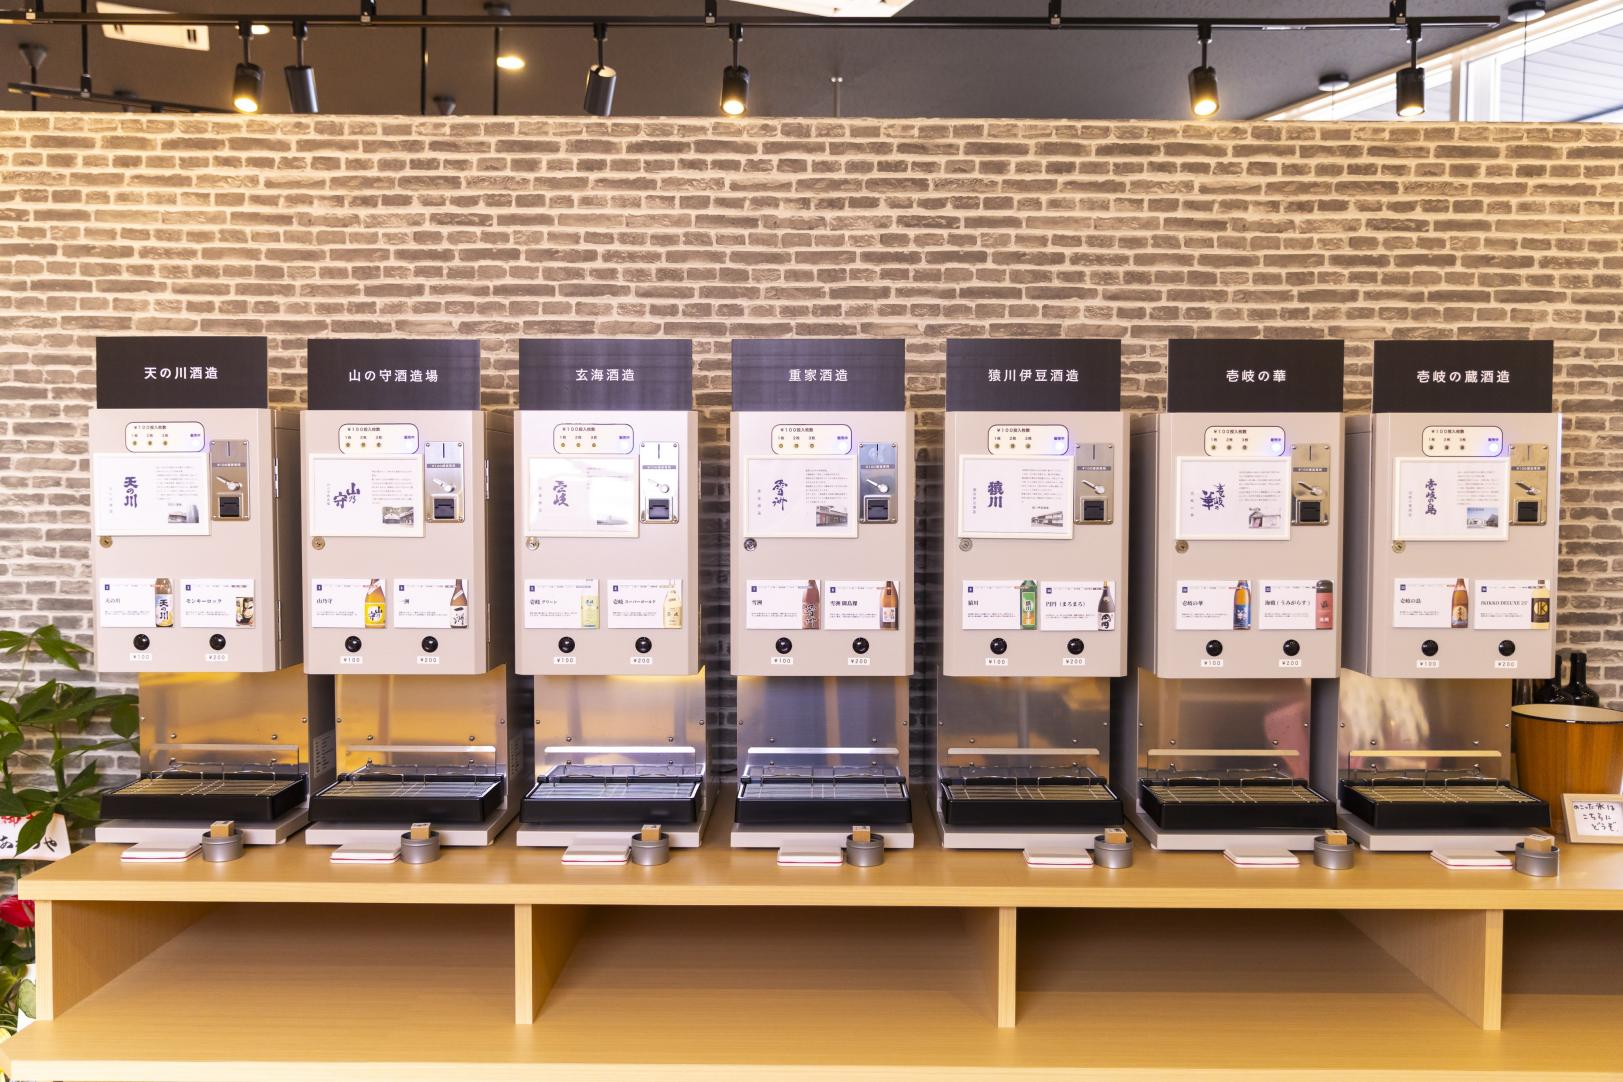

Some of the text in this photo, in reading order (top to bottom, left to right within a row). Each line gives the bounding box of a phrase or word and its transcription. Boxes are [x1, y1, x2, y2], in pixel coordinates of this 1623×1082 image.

[143, 366, 219, 380] 天の川酒造
[348, 369, 439, 383] 山の守酒造場
[575, 368, 636, 382] 玄海酒造
[788, 368, 849, 382] 重家酒造
[988, 368, 1080, 382] 猿川伊豆酒造
[1226, 369, 1287, 383] 壱岐の華
[1416, 370, 1511, 383] 壱岐の蔵酒造
[123, 476, 139, 509] 天の川
[159, 599, 169, 620] 天の川
[1582, 812, 1612, 821] こちらに
